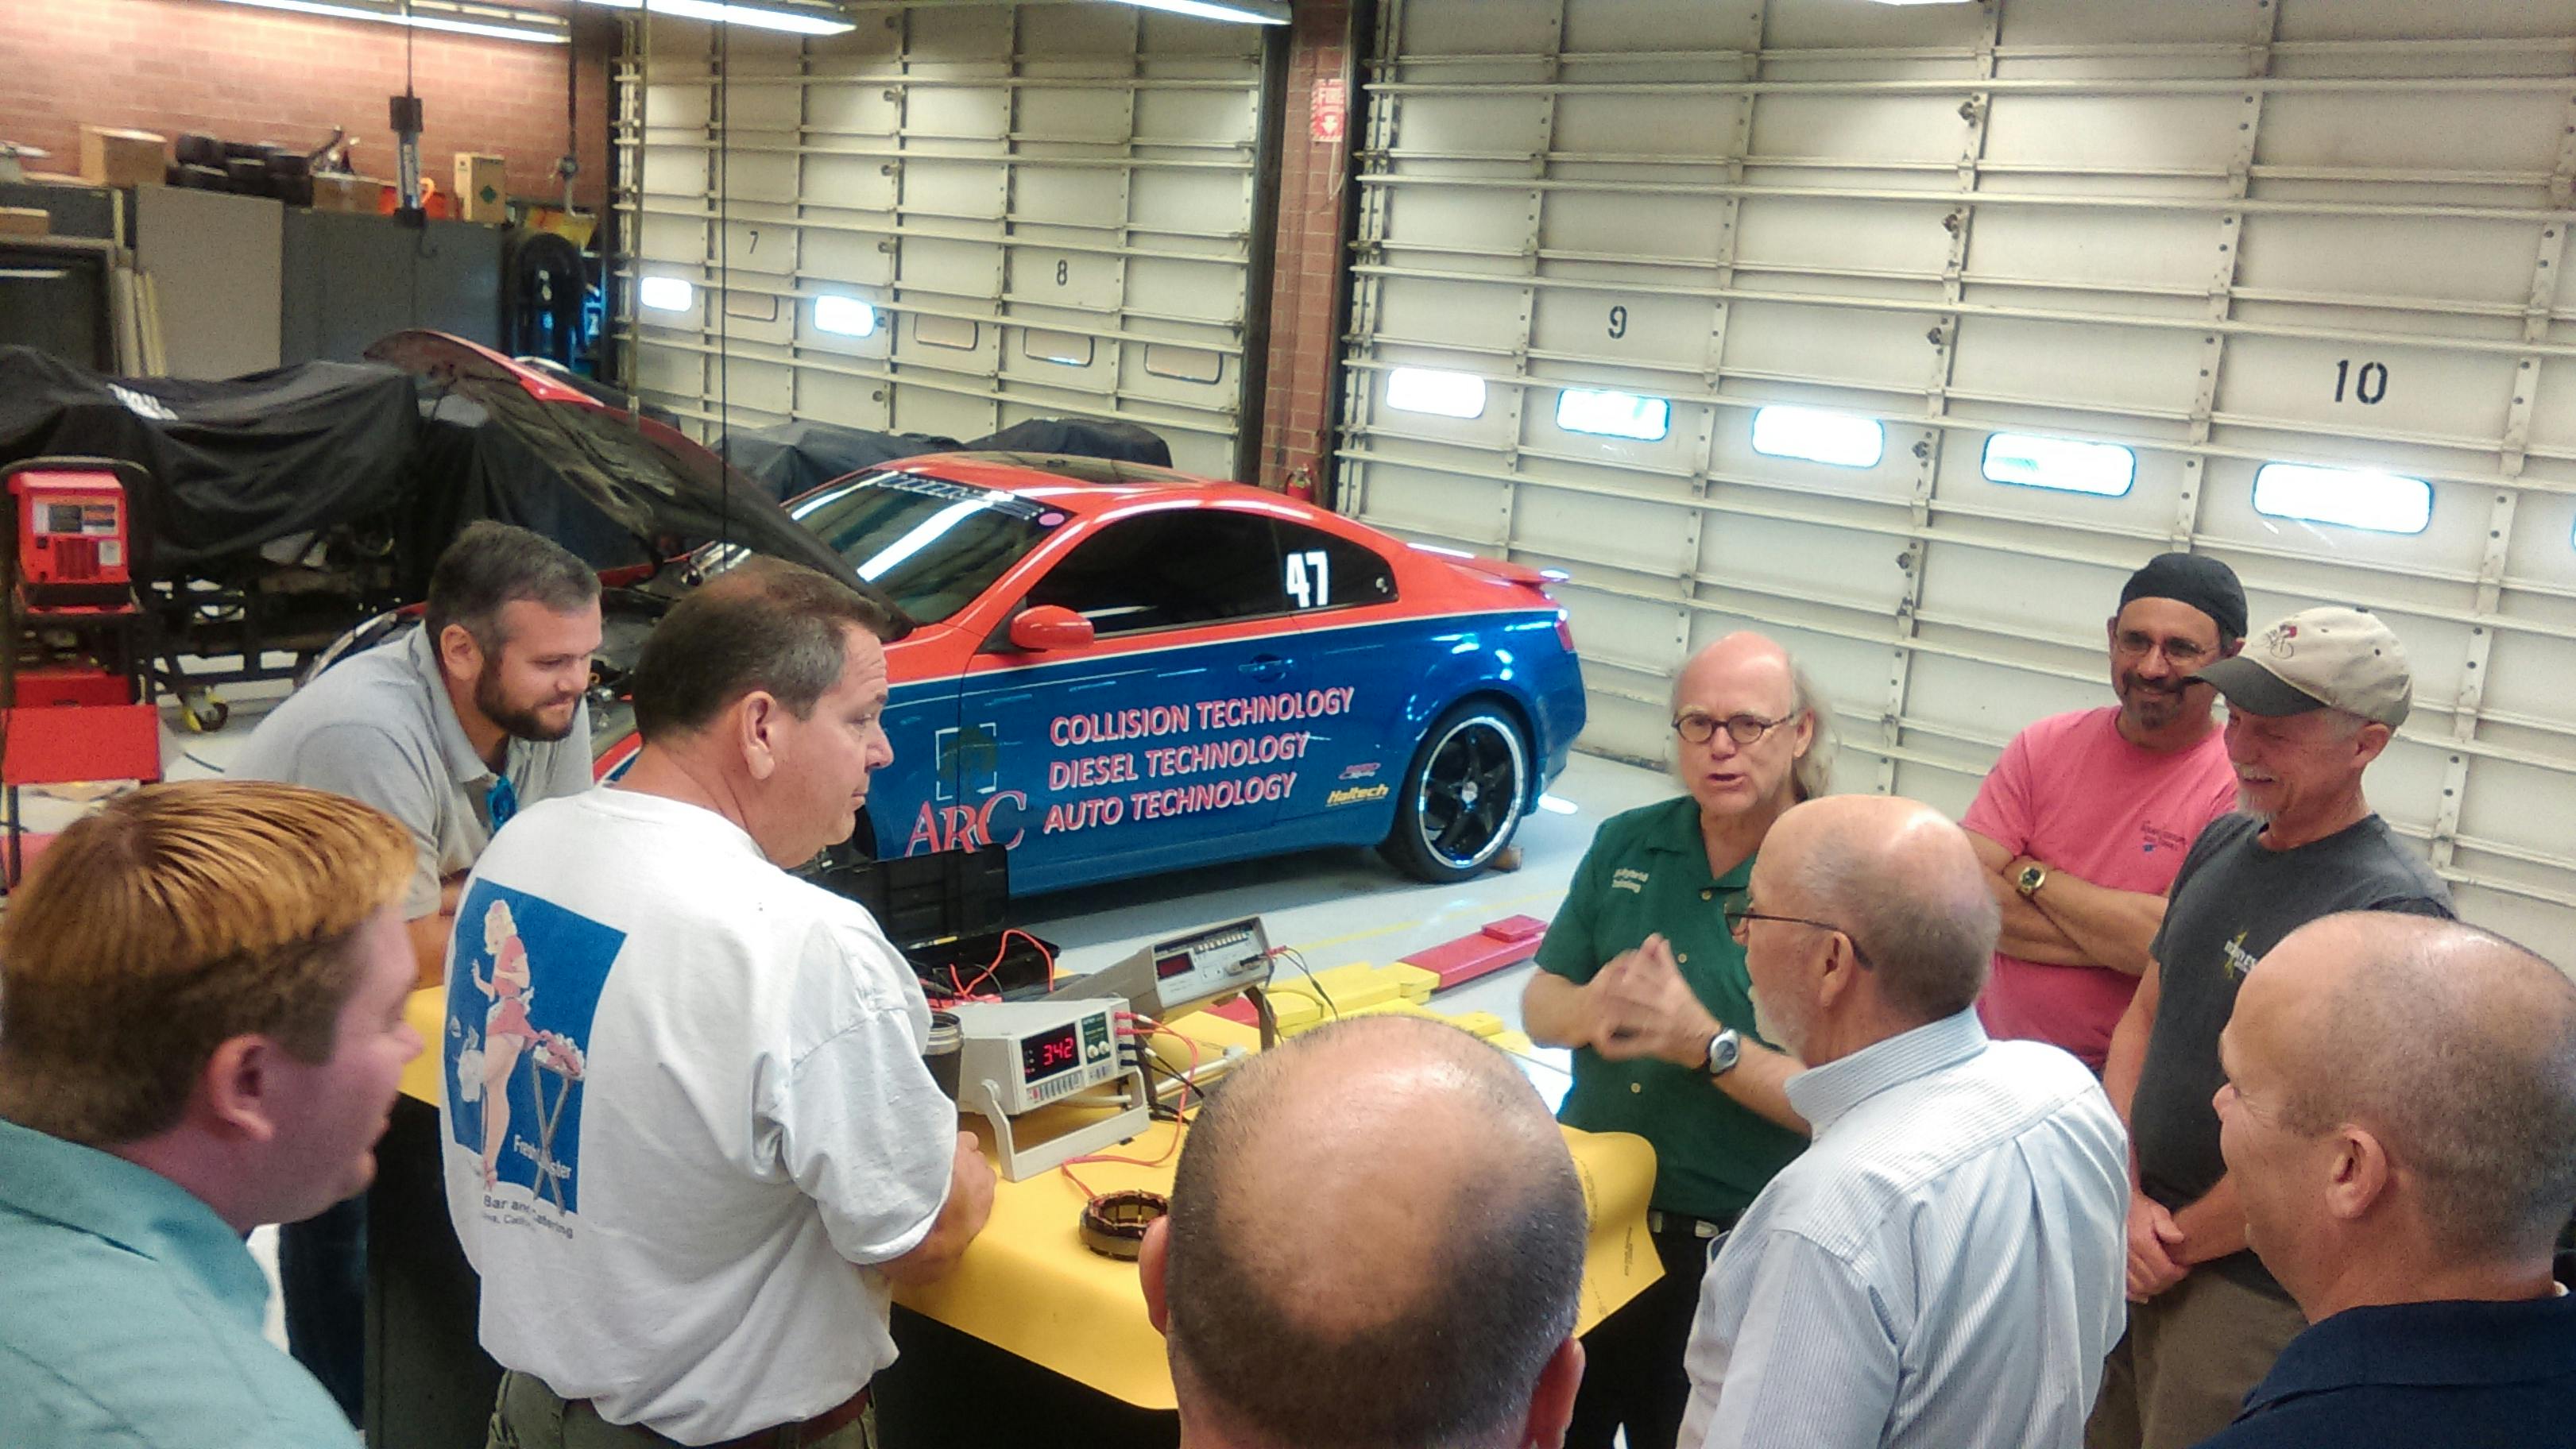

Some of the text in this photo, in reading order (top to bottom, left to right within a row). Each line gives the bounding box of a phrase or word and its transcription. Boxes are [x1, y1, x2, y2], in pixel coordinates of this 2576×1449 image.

[748, 230, 760, 254] 7
[1056, 258, 1068, 287] 8
[1607, 305, 1627, 339] 9
[2334, 359, 2388, 404] 10
[1286, 551, 1329, 608] 47
[1050, 686, 1355, 747] COLLISION TECHNOLOGY
[1048, 752, 1139, 791] DIESEL
[1144, 730, 1311, 778] TECHNOLOGY
[1042, 771, 1298, 835] AUTO TECHNOLOGY
[1326, 783, 1390, 805] Haltech
[903, 790, 1027, 858] ARC
[1042, 1036, 1074, 1066] 342
[483, 1194, 508, 1209] Bar
